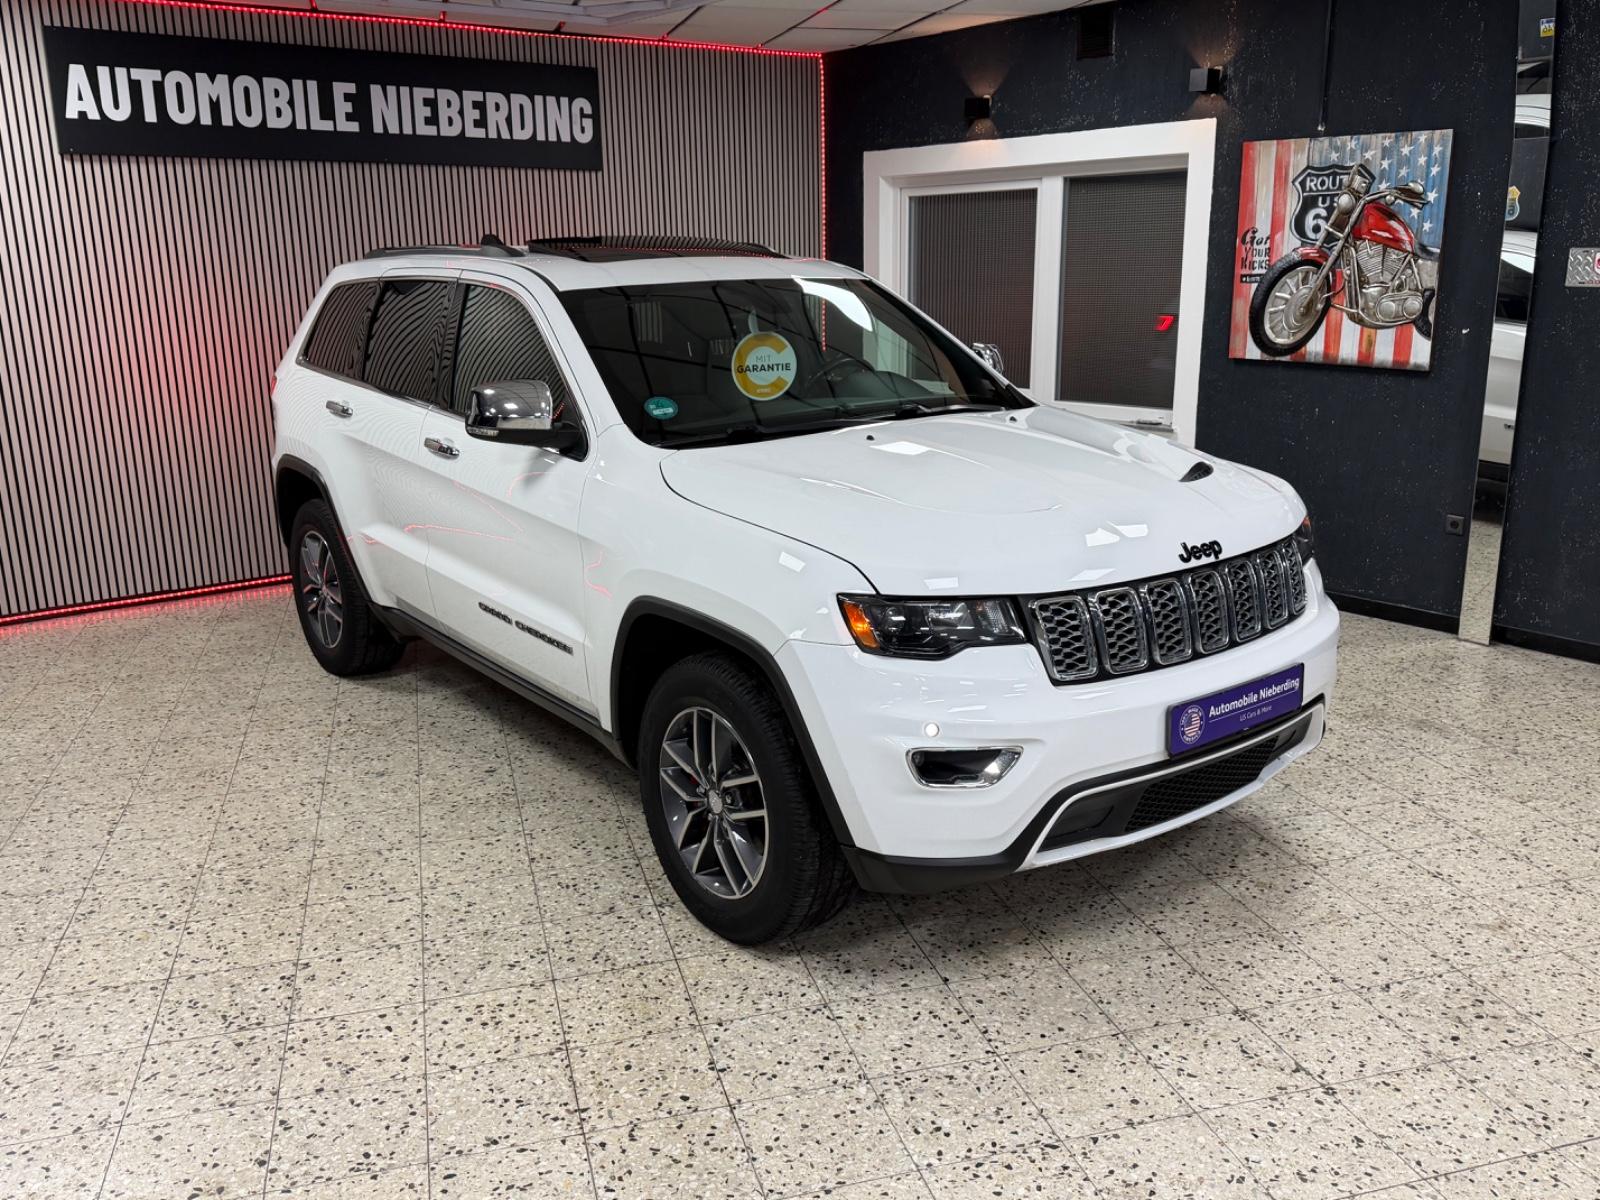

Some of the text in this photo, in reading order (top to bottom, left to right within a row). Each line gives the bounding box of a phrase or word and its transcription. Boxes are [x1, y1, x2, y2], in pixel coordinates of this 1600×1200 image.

[65, 63, 594, 144] AUTOMOBILE NIEBERDING
[1306, 175, 1350, 191] ROUT
[736, 362, 791, 374] GARANTIE
[755, 354, 771, 363] MIT
[1178, 540, 1222, 563] Jeep
[1209, 678, 1300, 718] Automobile Nieberding
